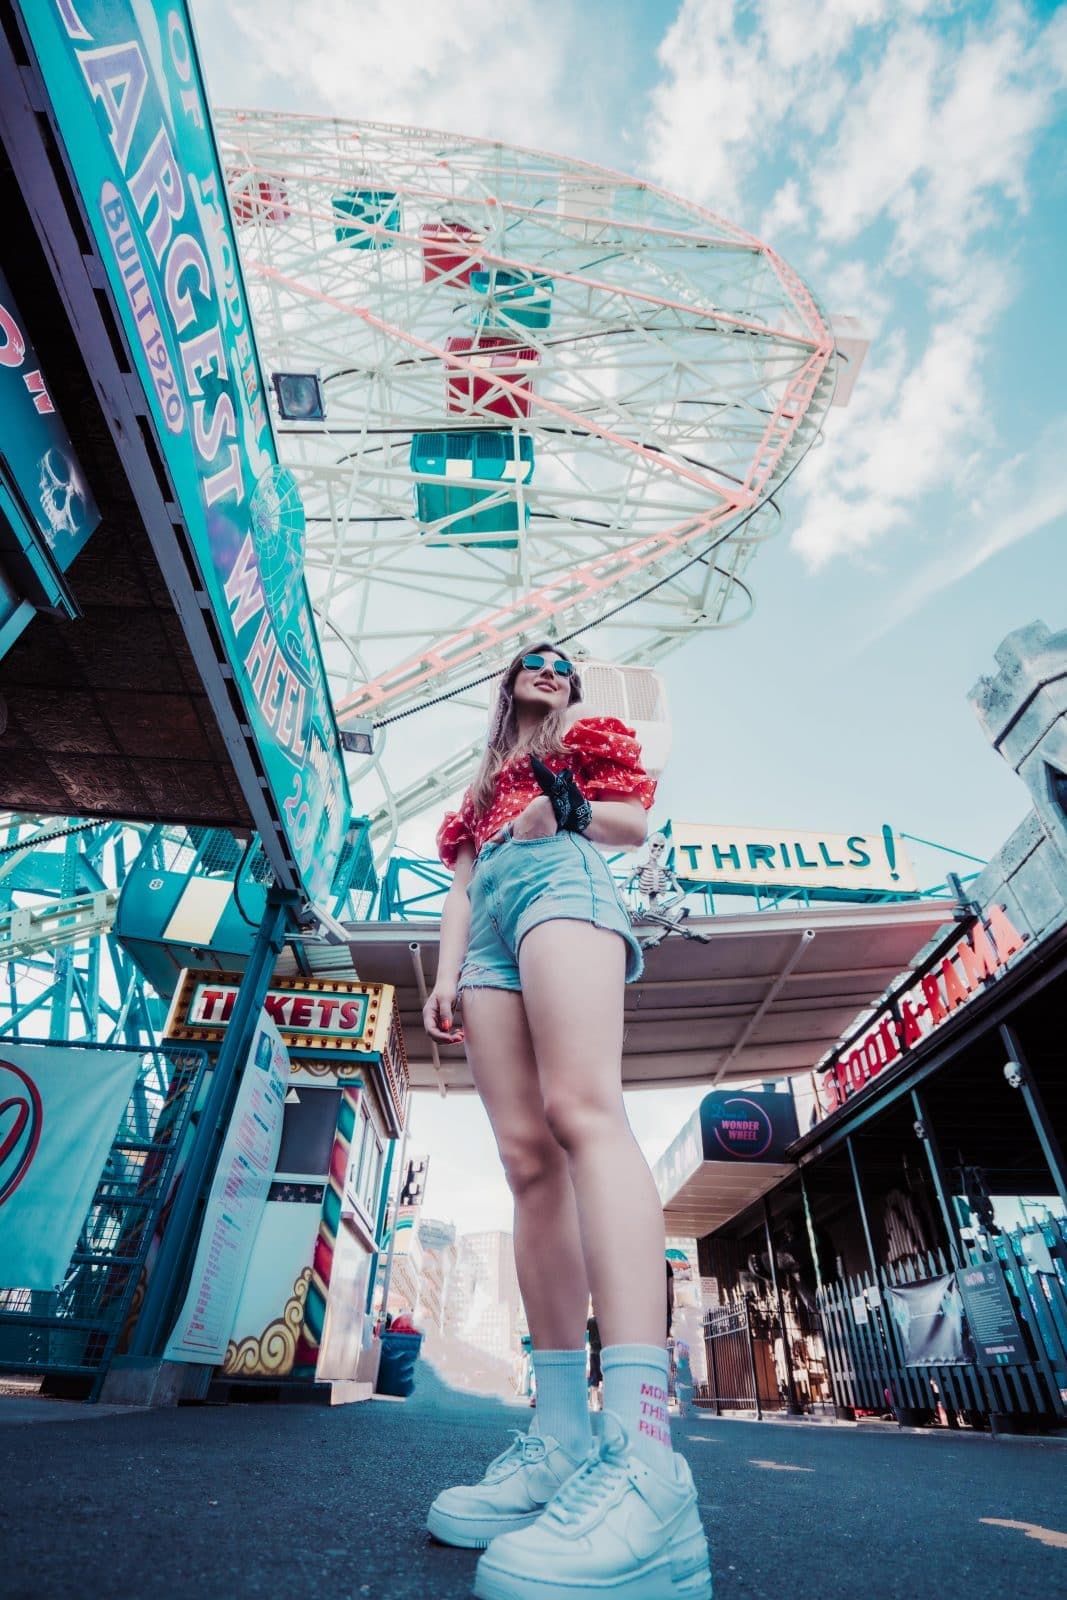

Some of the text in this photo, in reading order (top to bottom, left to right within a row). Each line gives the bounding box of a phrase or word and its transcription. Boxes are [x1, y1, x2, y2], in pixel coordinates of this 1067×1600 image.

[168, 10, 204, 129] OF
[104, 197, 182, 423] BUILT 1920
[223, 528, 306, 758] WHEEL
[680, 824, 899, 881] THRILLS!
[202, 991, 359, 1029] TIKETS
[822, 904, 1025, 1114] SPOOK-A-RAMA
[721, 1120, 760, 1130] WONDER
[728, 1130, 757, 1140] WHEEL
